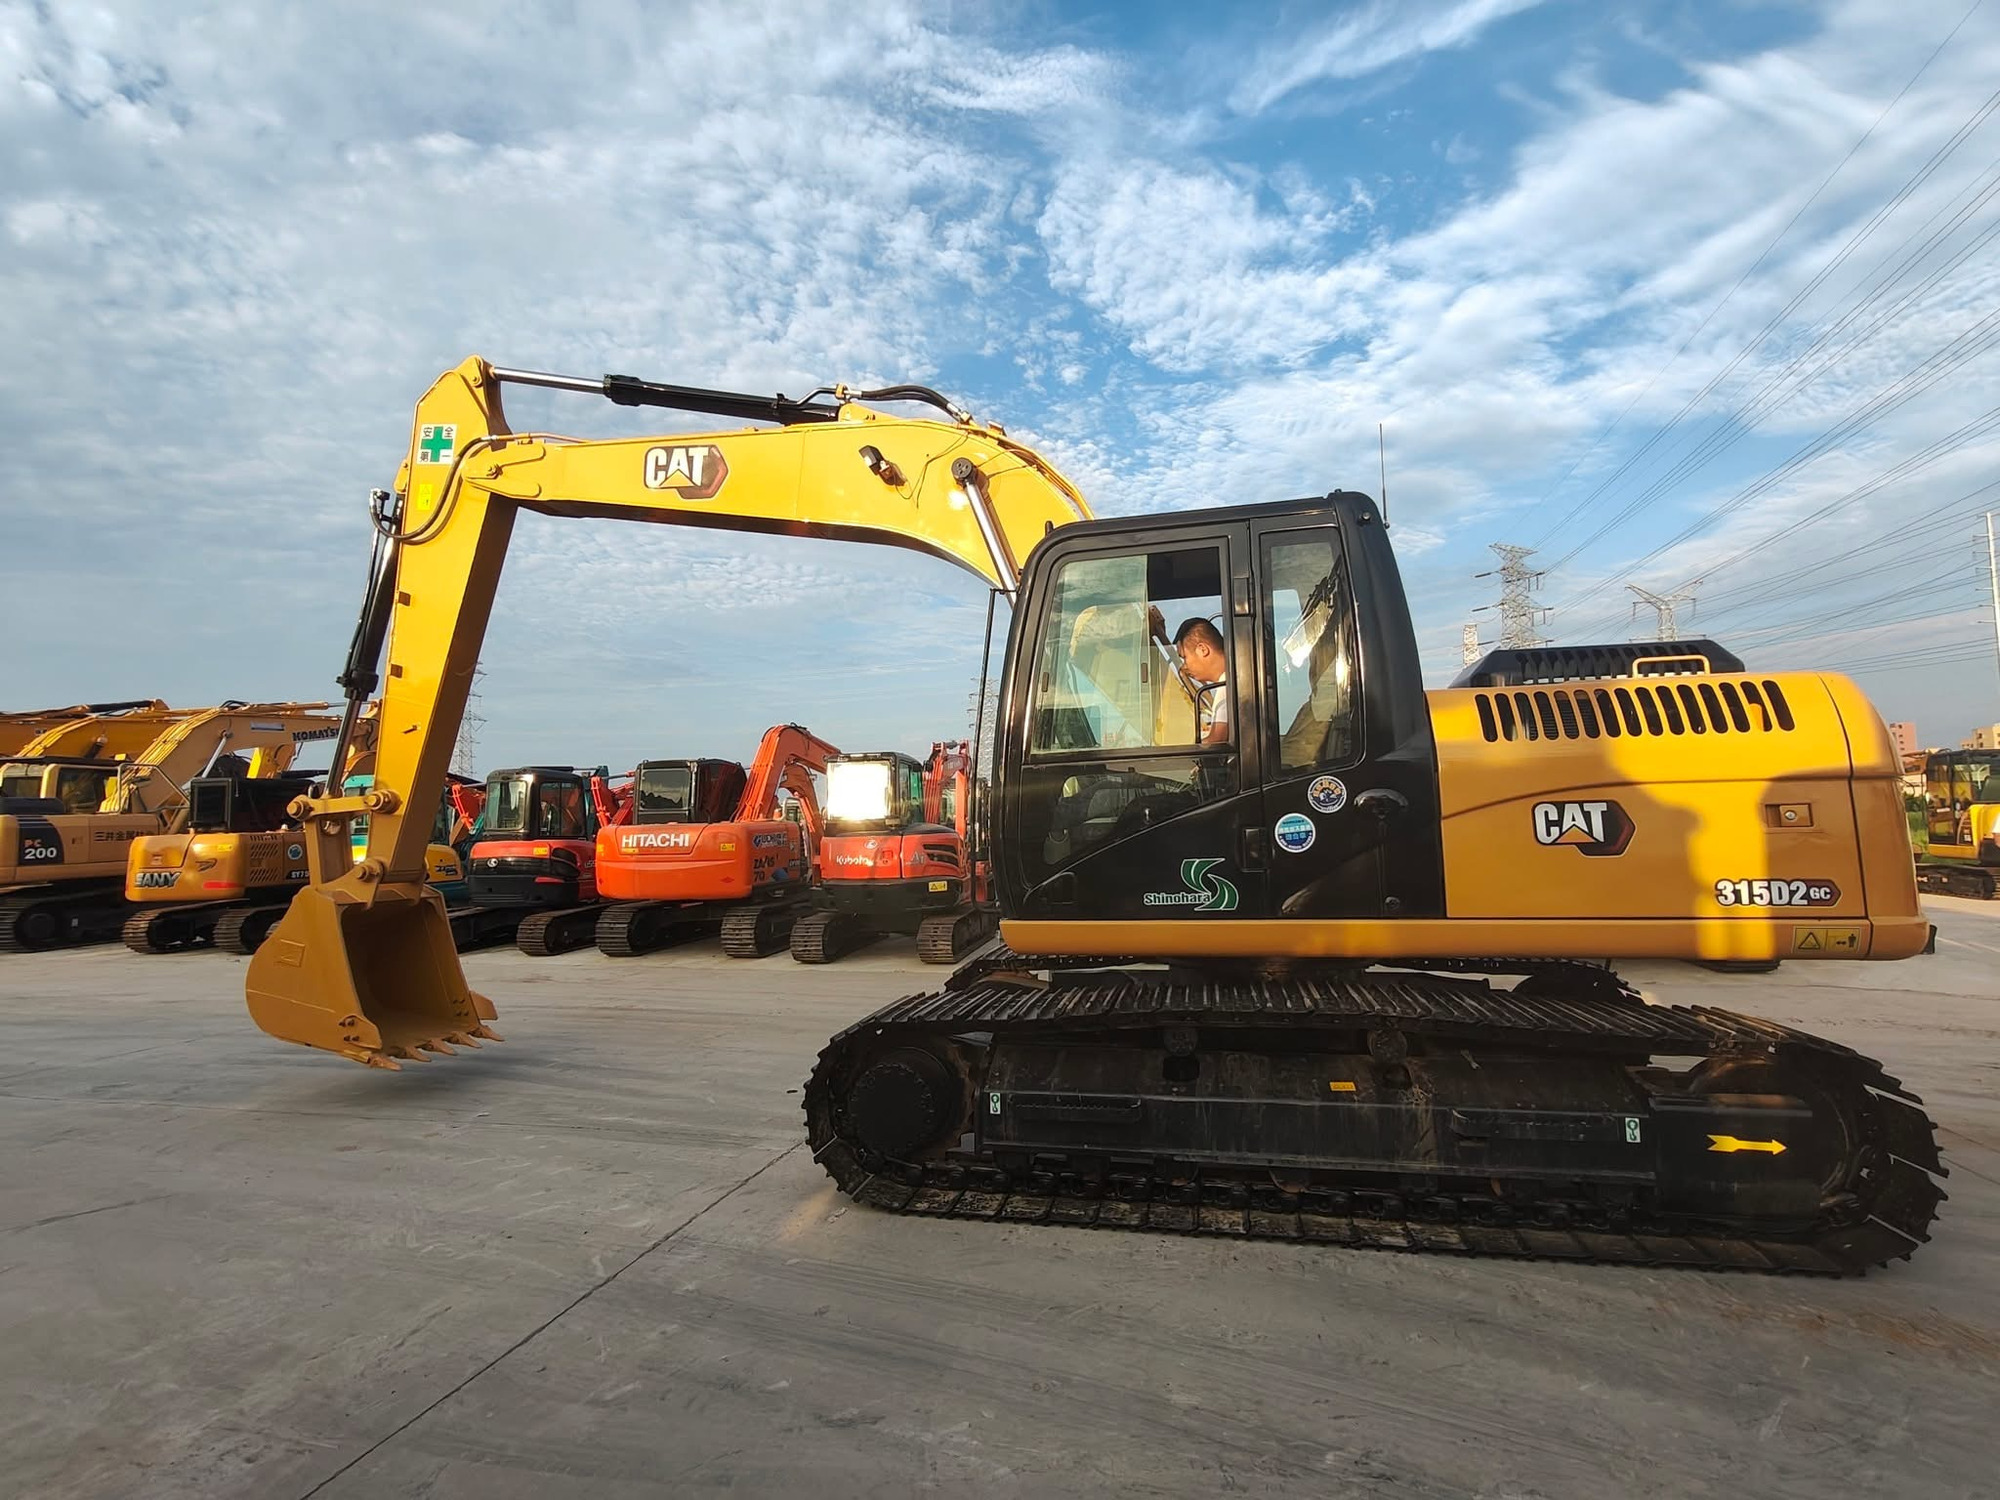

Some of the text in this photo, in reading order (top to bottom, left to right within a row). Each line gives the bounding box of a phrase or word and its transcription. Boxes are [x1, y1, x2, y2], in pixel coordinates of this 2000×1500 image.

[645, 446, 709, 488] CAT
[1534, 802, 1607, 844] CAT
[24, 838, 41, 848] PC
[621, 833, 690, 848] HITACHI
[24, 847, 57, 860] 200
[836, 854, 871, 866] Kubota
[134, 872, 181, 888] SANY
[1143, 892, 1212, 906] Shinohara
[1716, 880, 1831, 905] 315D2 GC
